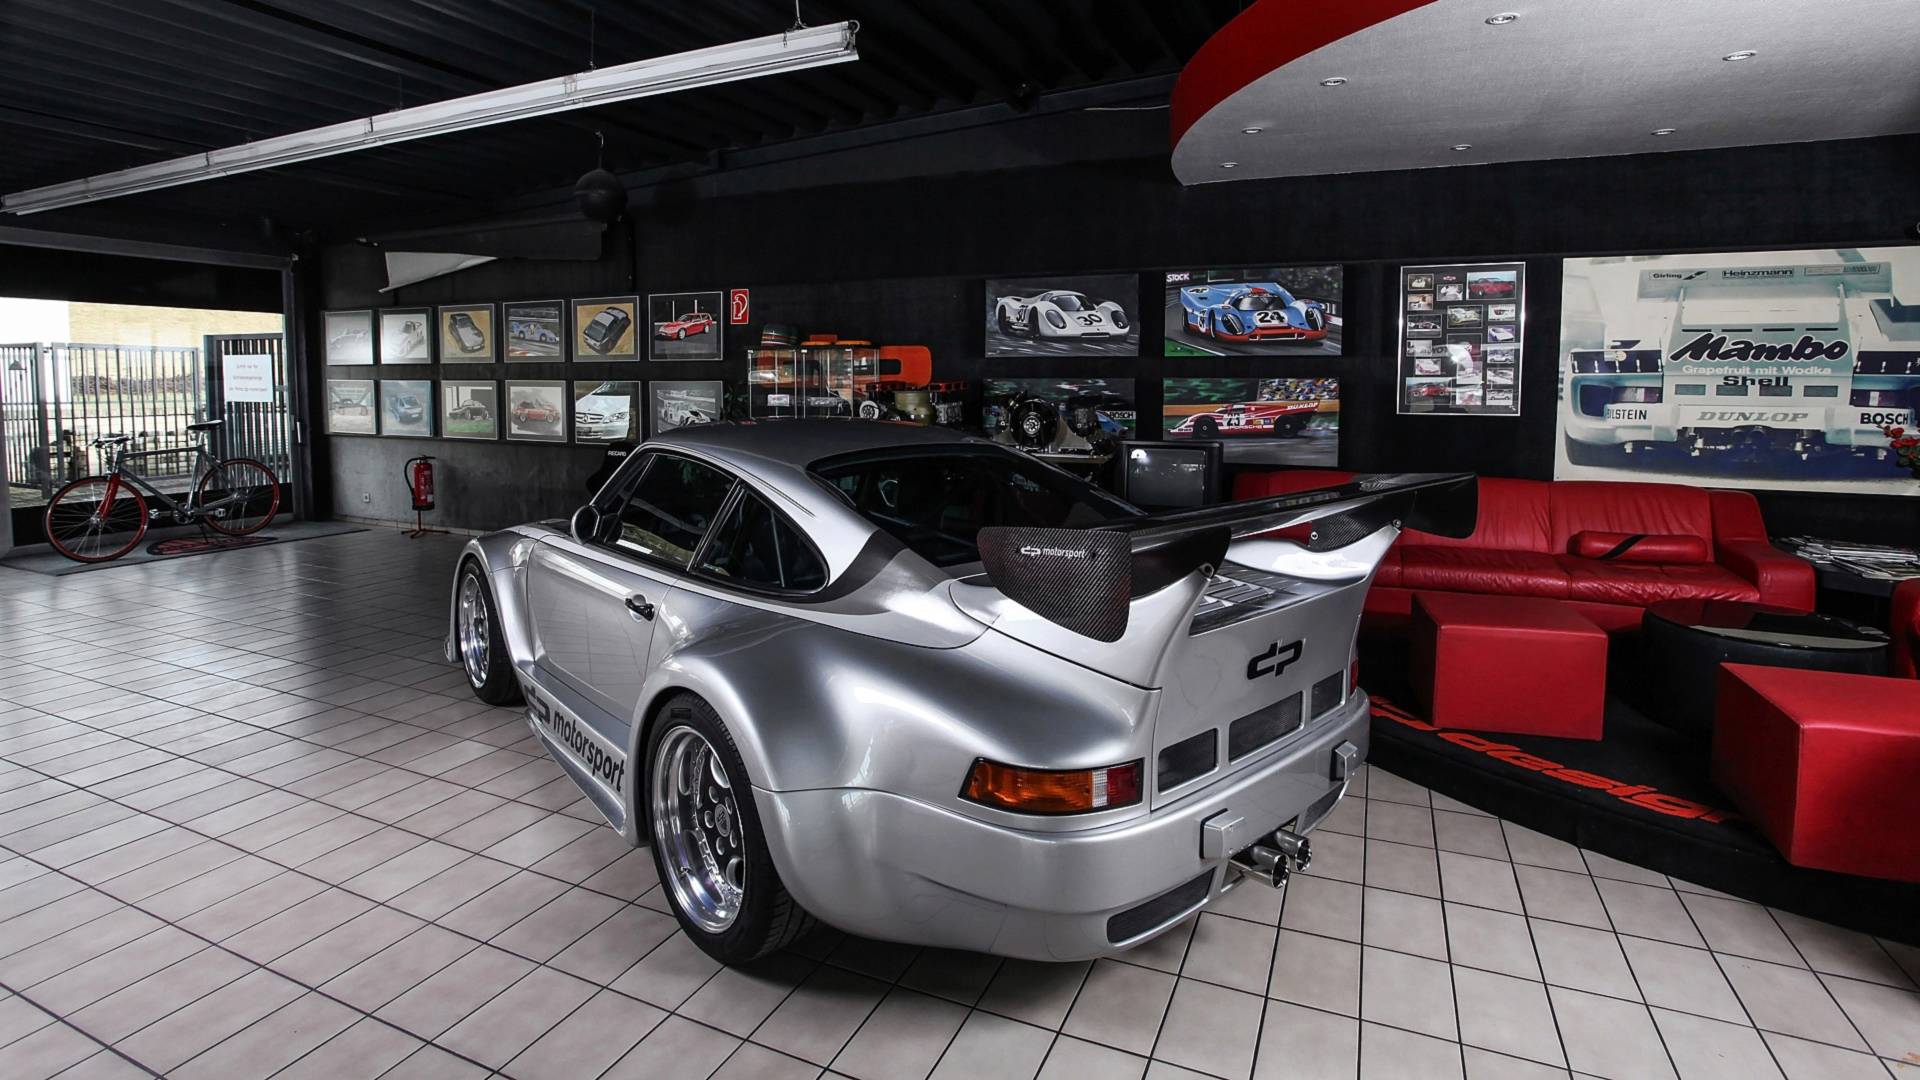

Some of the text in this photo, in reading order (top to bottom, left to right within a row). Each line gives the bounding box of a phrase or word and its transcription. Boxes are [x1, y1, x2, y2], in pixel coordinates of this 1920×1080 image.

[1166, 273, 1190, 283] STOCK
[1723, 269, 1793, 278] Heinzmann
[1076, 313, 1103, 327] 30
[1256, 310, 1286, 325] 24
[1669, 332, 1849, 361] Mambo
[1682, 365, 1832, 376] Grapefruit mit Wodka
[1723, 376, 1789, 387] Shell
[1696, 410, 1809, 423] DUNLOP
[1860, 412, 1909, 426] BOSCH
[1042, 546, 1086, 560] motorsport
[553, 710, 625, 793] motorsport
